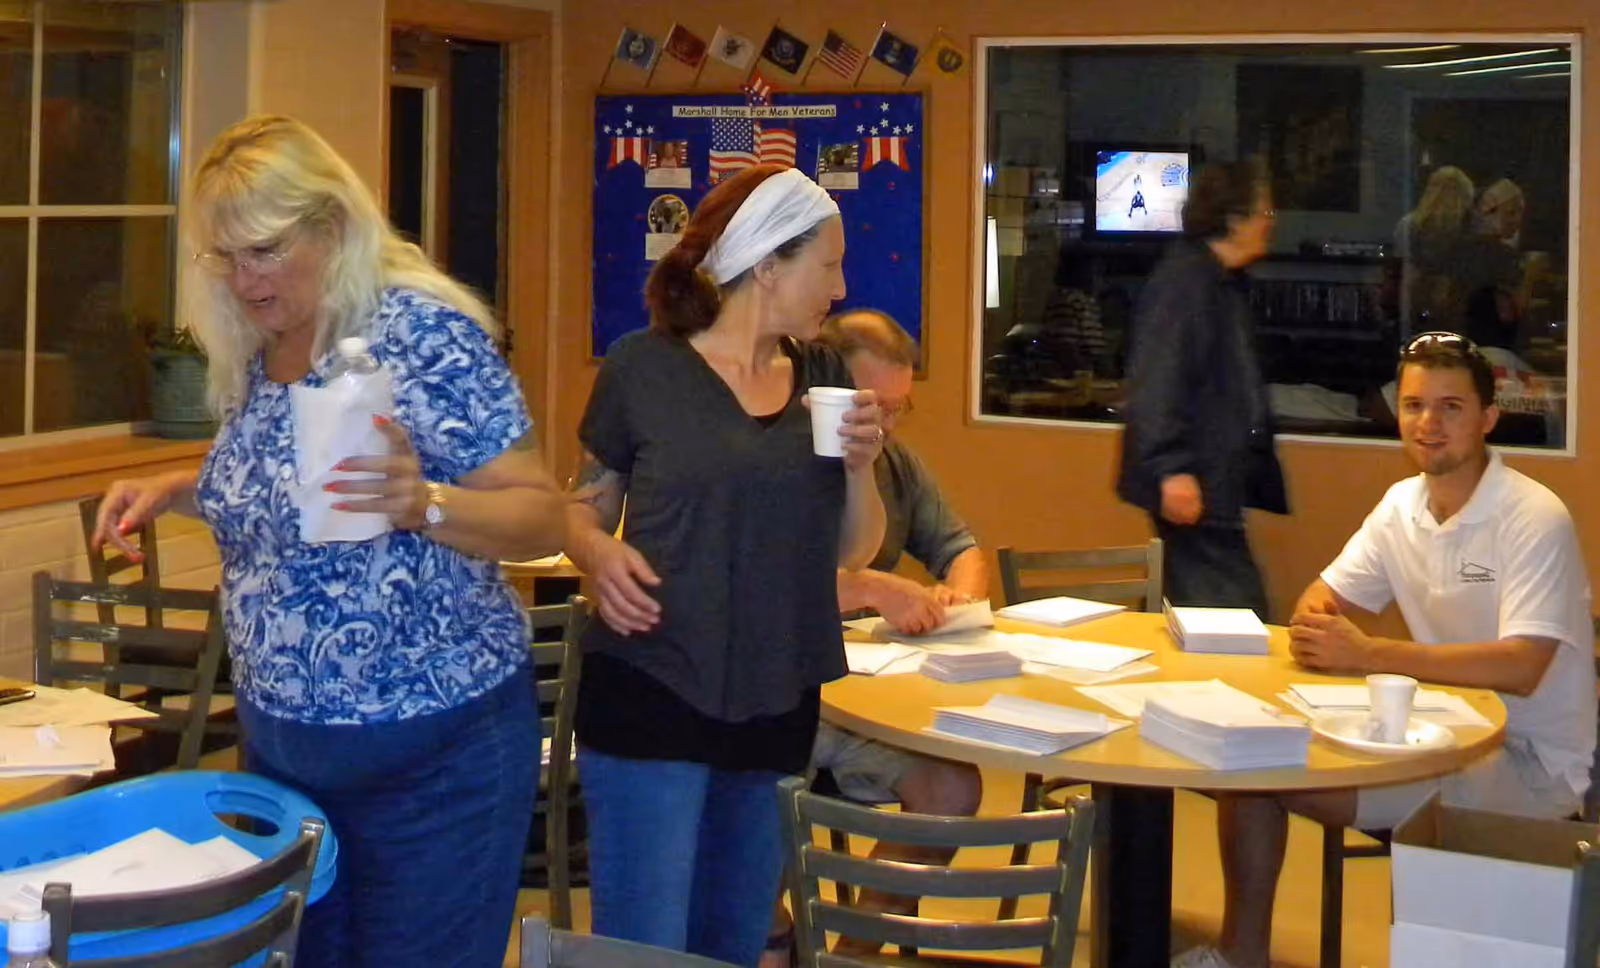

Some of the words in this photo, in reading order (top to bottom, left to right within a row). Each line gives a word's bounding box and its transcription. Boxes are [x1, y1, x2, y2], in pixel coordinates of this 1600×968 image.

[678, 106, 717, 116] Marshall
[721, 106, 746, 116] Home
[750, 106, 767, 117] For
[769, 106, 789, 117] Men
[792, 105, 836, 117] Veterans
